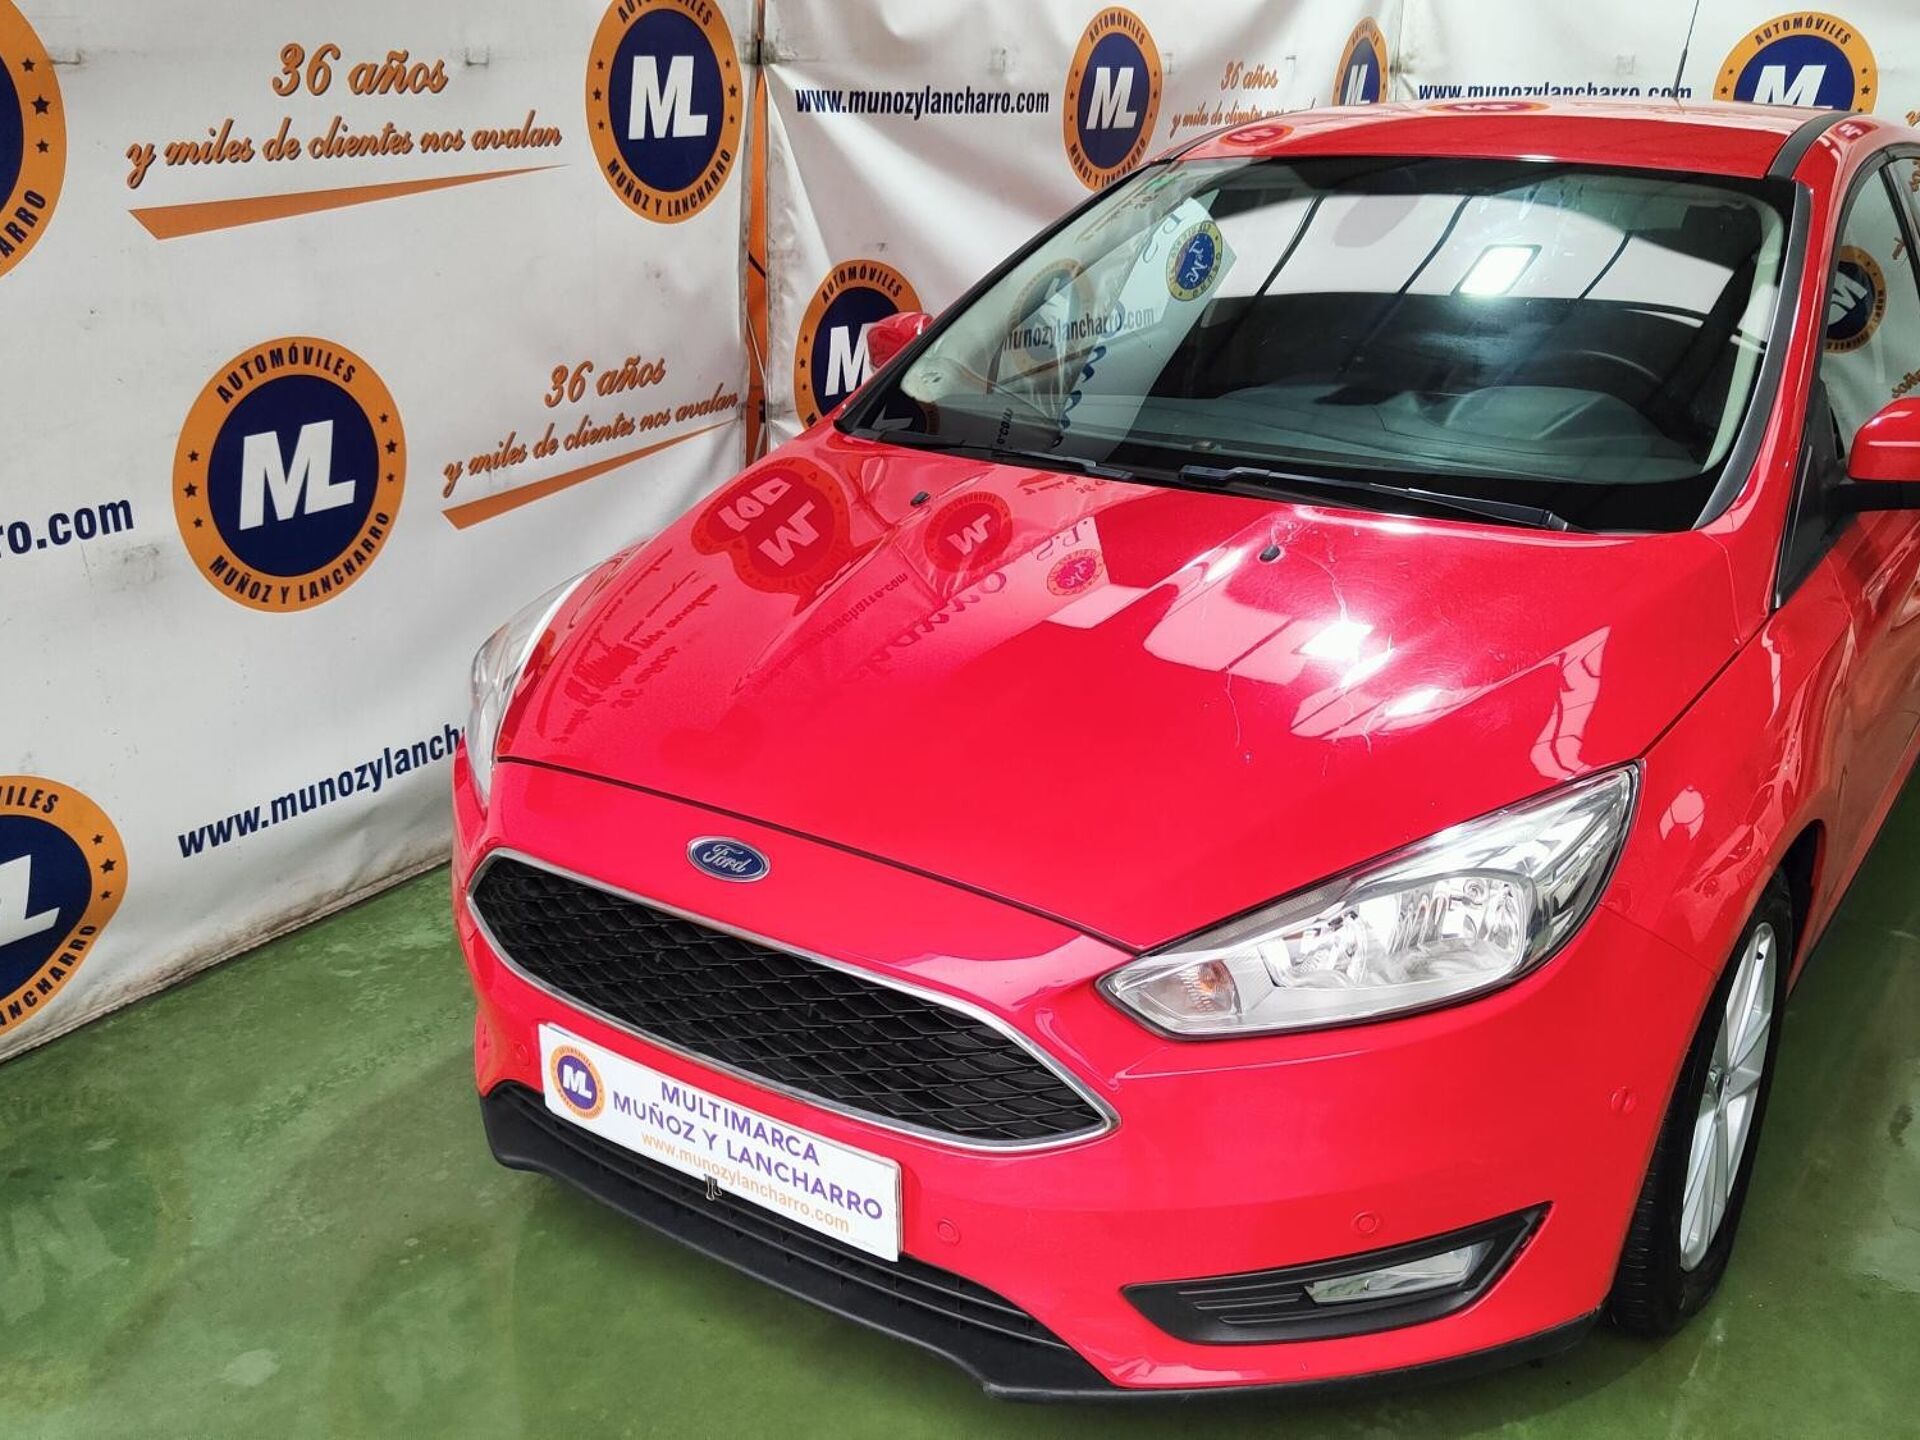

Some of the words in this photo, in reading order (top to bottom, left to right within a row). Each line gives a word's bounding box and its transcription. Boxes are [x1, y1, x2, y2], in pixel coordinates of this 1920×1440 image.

[1755, 14, 1851, 46] AUTOMÓVILES
[271, 43, 341, 97] 36
[347, 49, 449, 96] años
[628, 55, 708, 140] ML
[1085, 67, 1137, 130] ML
[1221, 61, 1244, 91] 36
[1242, 63, 1279, 91] años
[795, 85, 1049, 121] www.munozylancharro.com
[1169, 113, 1181, 140] y
[1182, 101, 1208, 127] miles
[1211, 100, 1223, 126] de
[126, 142, 156, 189] y
[164, 117, 255, 166] miles
[262, 117, 301, 161] de
[308, 115, 413, 159] clientes
[420, 128, 466, 154] nos
[471, 109, 562, 149] avalan
[607, 158, 649, 211] MUÑOZ
[655, 198, 662, 216] Y
[667, 149, 731, 217] LANCHARRO
[822, 264, 903, 304] AUTOMÓVILES
[215, 342, 357, 404] AUTOMÓVILES
[545, 360, 594, 408] 36
[596, 355, 666, 397] años
[825, 322, 873, 397] M
[443, 460, 463, 498] y
[468, 431, 527, 477] miles
[533, 423, 559, 462] de
[563, 415, 636, 451] clientes
[639, 408, 671, 433] nos
[675, 382, 739, 422] avalan
[239, 419, 356, 531] ML
[209, 554, 271, 604] MUÑOZ
[281, 585, 290, 604] Y
[299, 511, 389, 602] LANCHARRO
[178, 723, 461, 858] www.munozylanch
[702, 844, 752, 873] Ford
[562, 1064, 592, 1100] ML
[613, 1091, 696, 1143] MUÑOZ
[703, 1129, 719, 1152] Y
[726, 1139, 882, 1220] LANCHARRO
[661, 1081, 820, 1166] MULTIMARCA
[641, 1132, 849, 1233] www.munozylancharro.com
